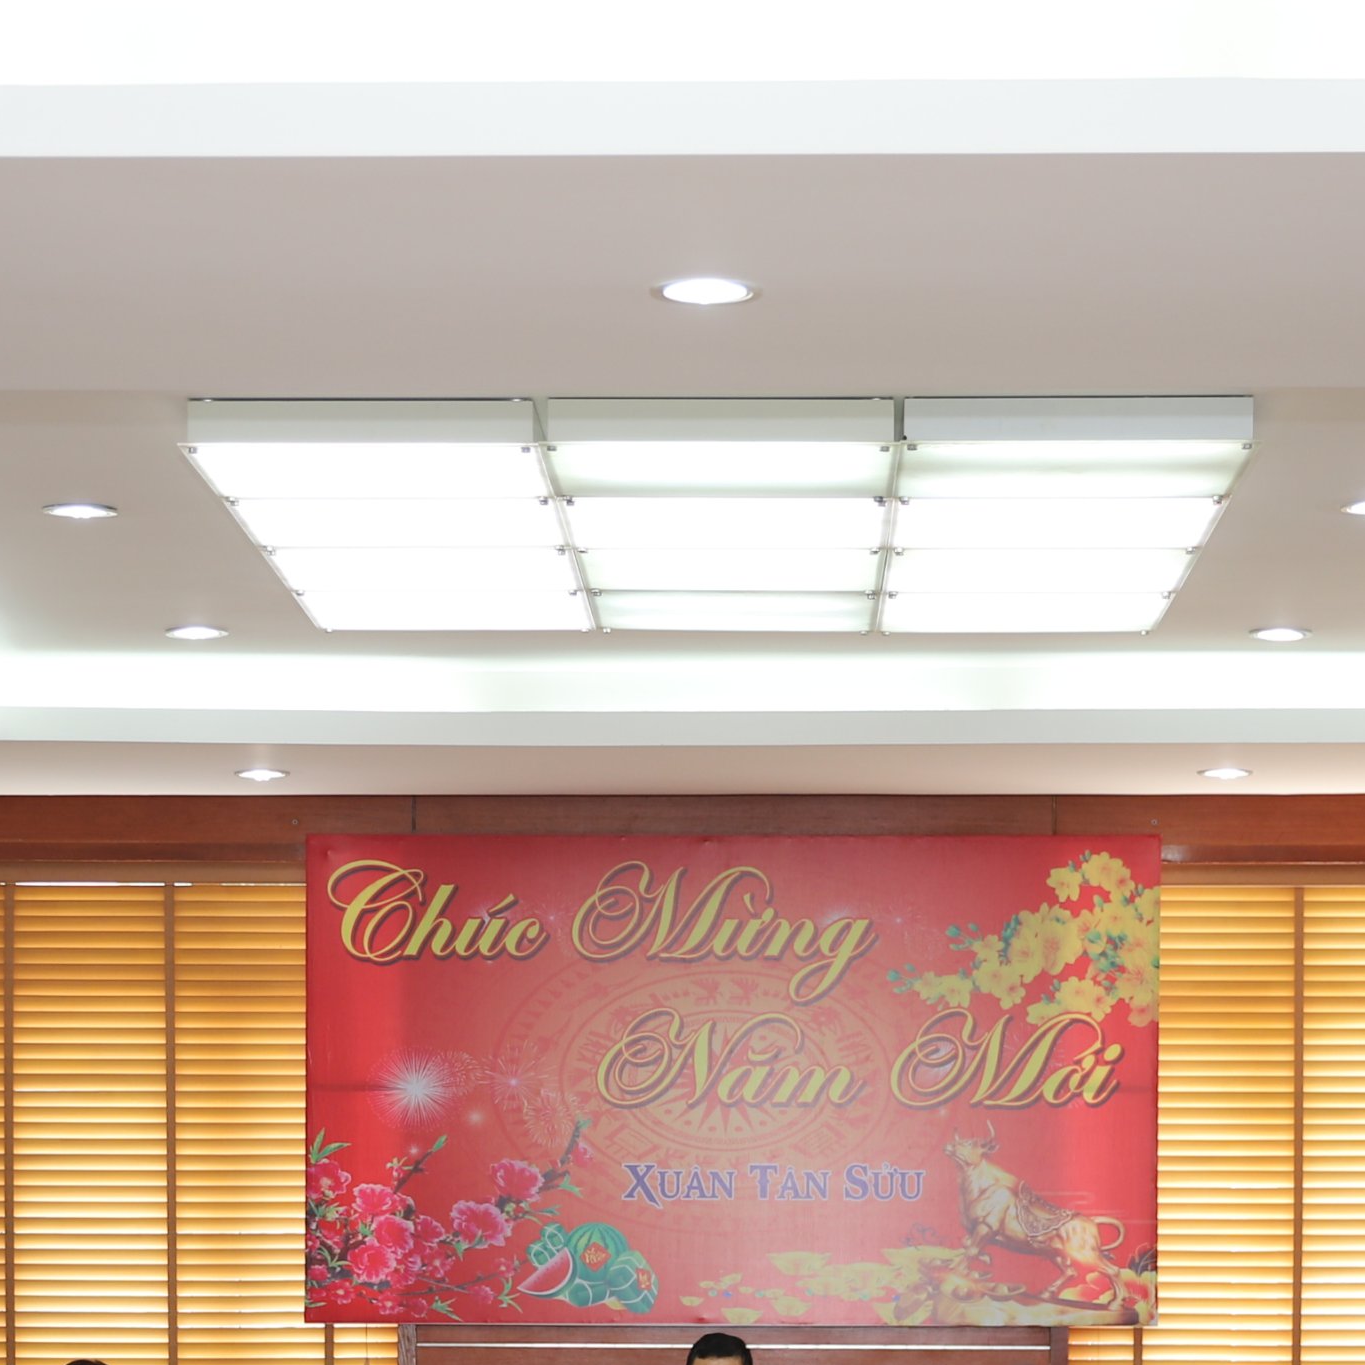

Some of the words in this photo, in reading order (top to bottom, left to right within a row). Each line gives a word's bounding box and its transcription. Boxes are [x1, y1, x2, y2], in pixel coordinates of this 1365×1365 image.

[327, 858, 549, 964] Chúc
[571, 860, 879, 1004] Mừng
[596, 1007, 866, 1108] Năm
[890, 1008, 1123, 1109] Mới
[622, 1162, 737, 1209] XUÂN
[747, 1163, 832, 1201] TÂN
[842, 1160, 927, 1202] SỬU
